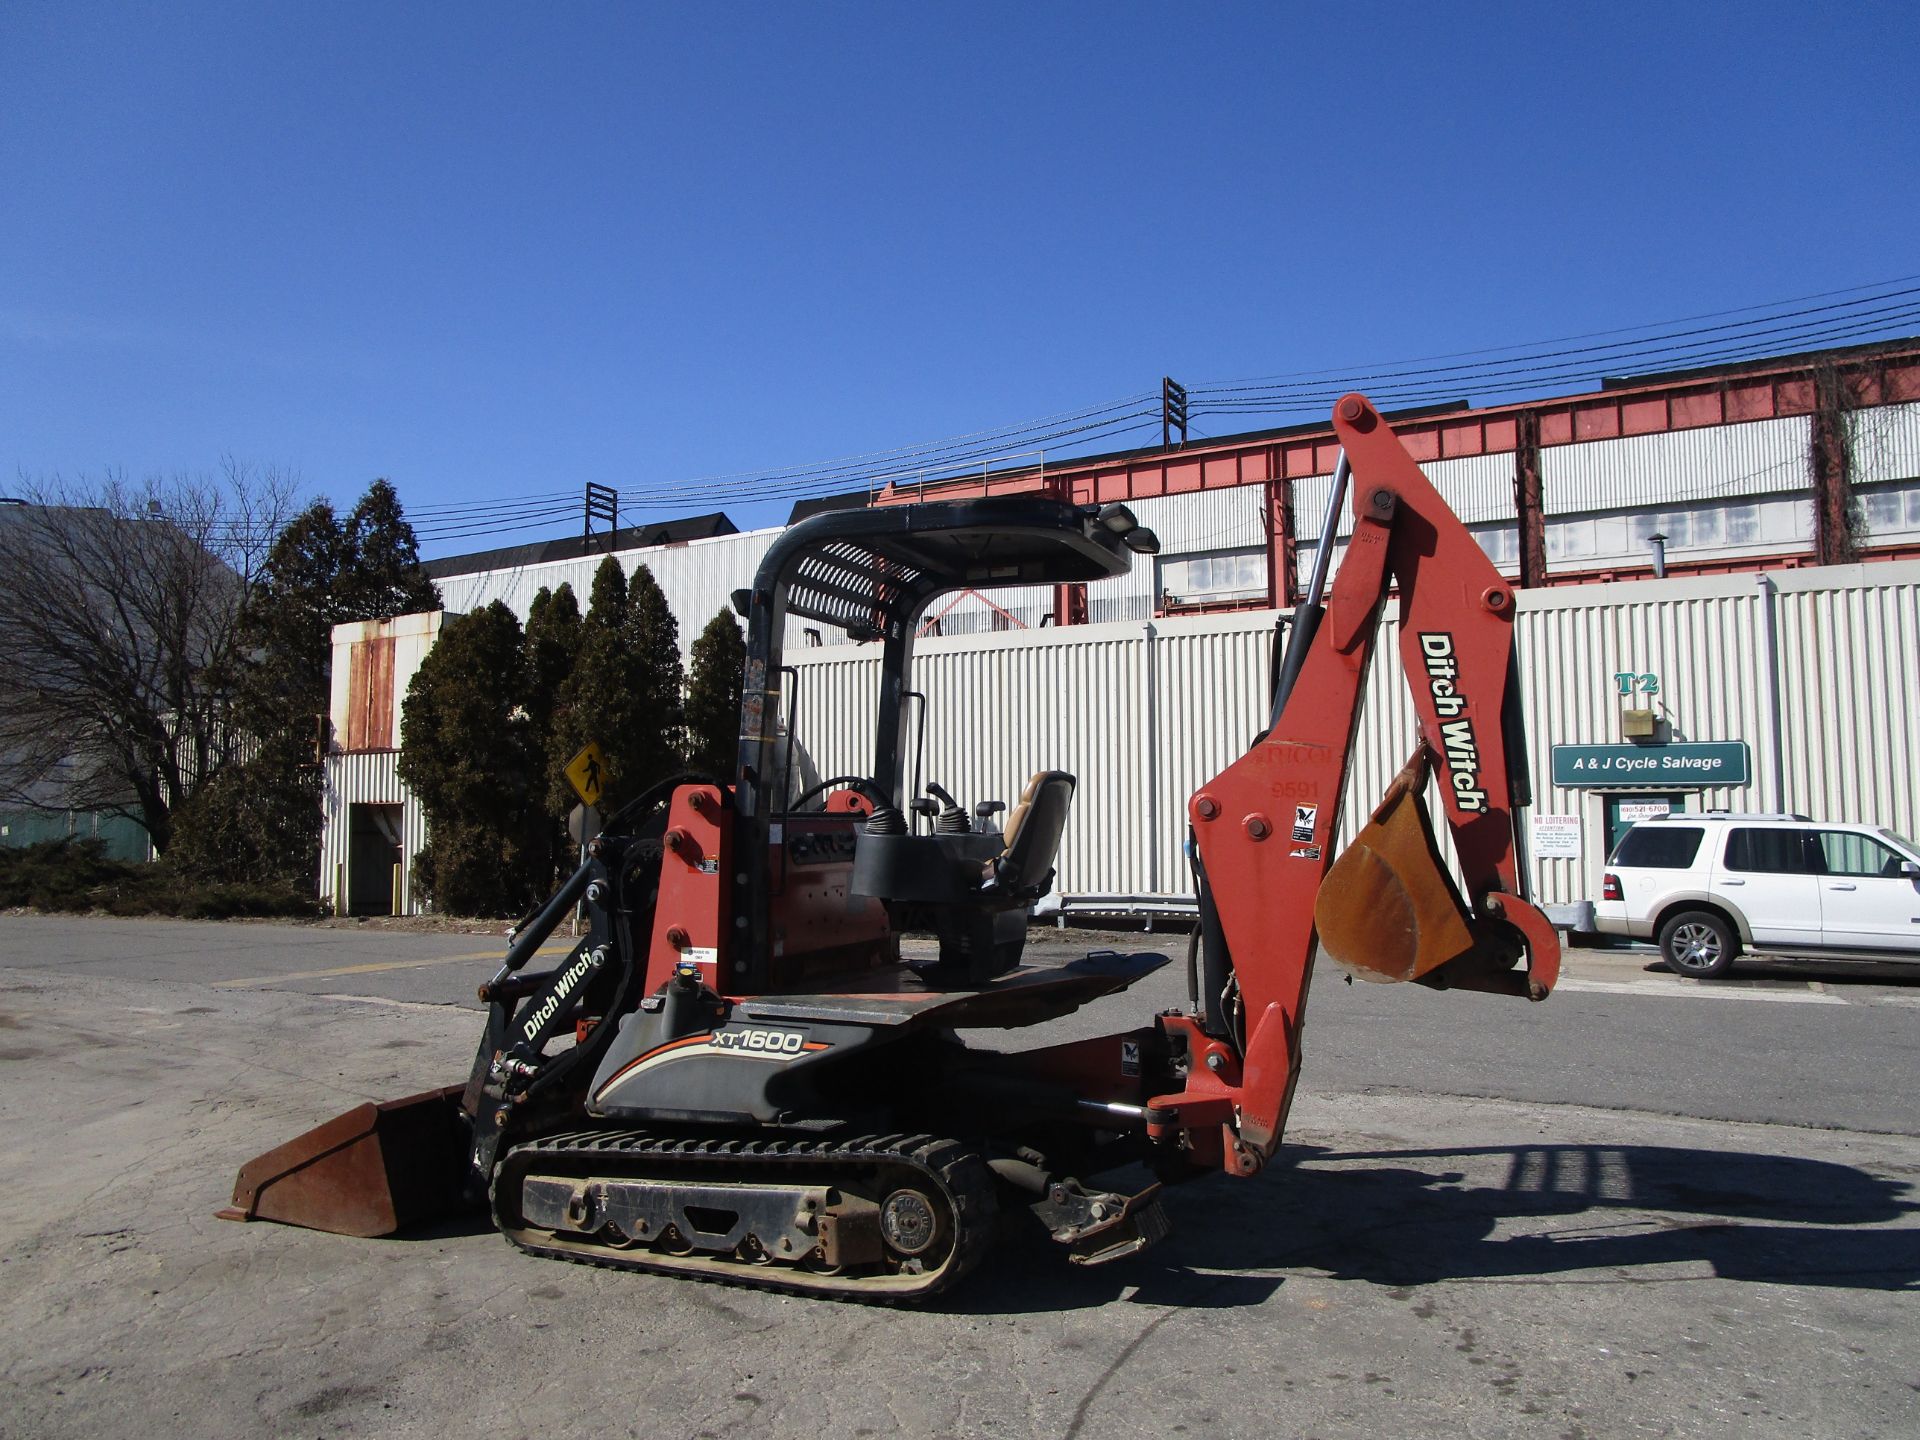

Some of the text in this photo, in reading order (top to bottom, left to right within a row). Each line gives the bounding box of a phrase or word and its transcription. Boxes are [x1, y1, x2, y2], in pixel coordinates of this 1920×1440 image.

[1420, 634, 1465, 717] Ditch
[1614, 672, 1660, 694] T2
[1573, 756, 1722, 772] A & J Cycle Salvage
[1272, 782, 1319, 798] 9591
[1534, 816, 1579, 824] NO LOITERING
[523, 994, 559, 1041] Ditch
